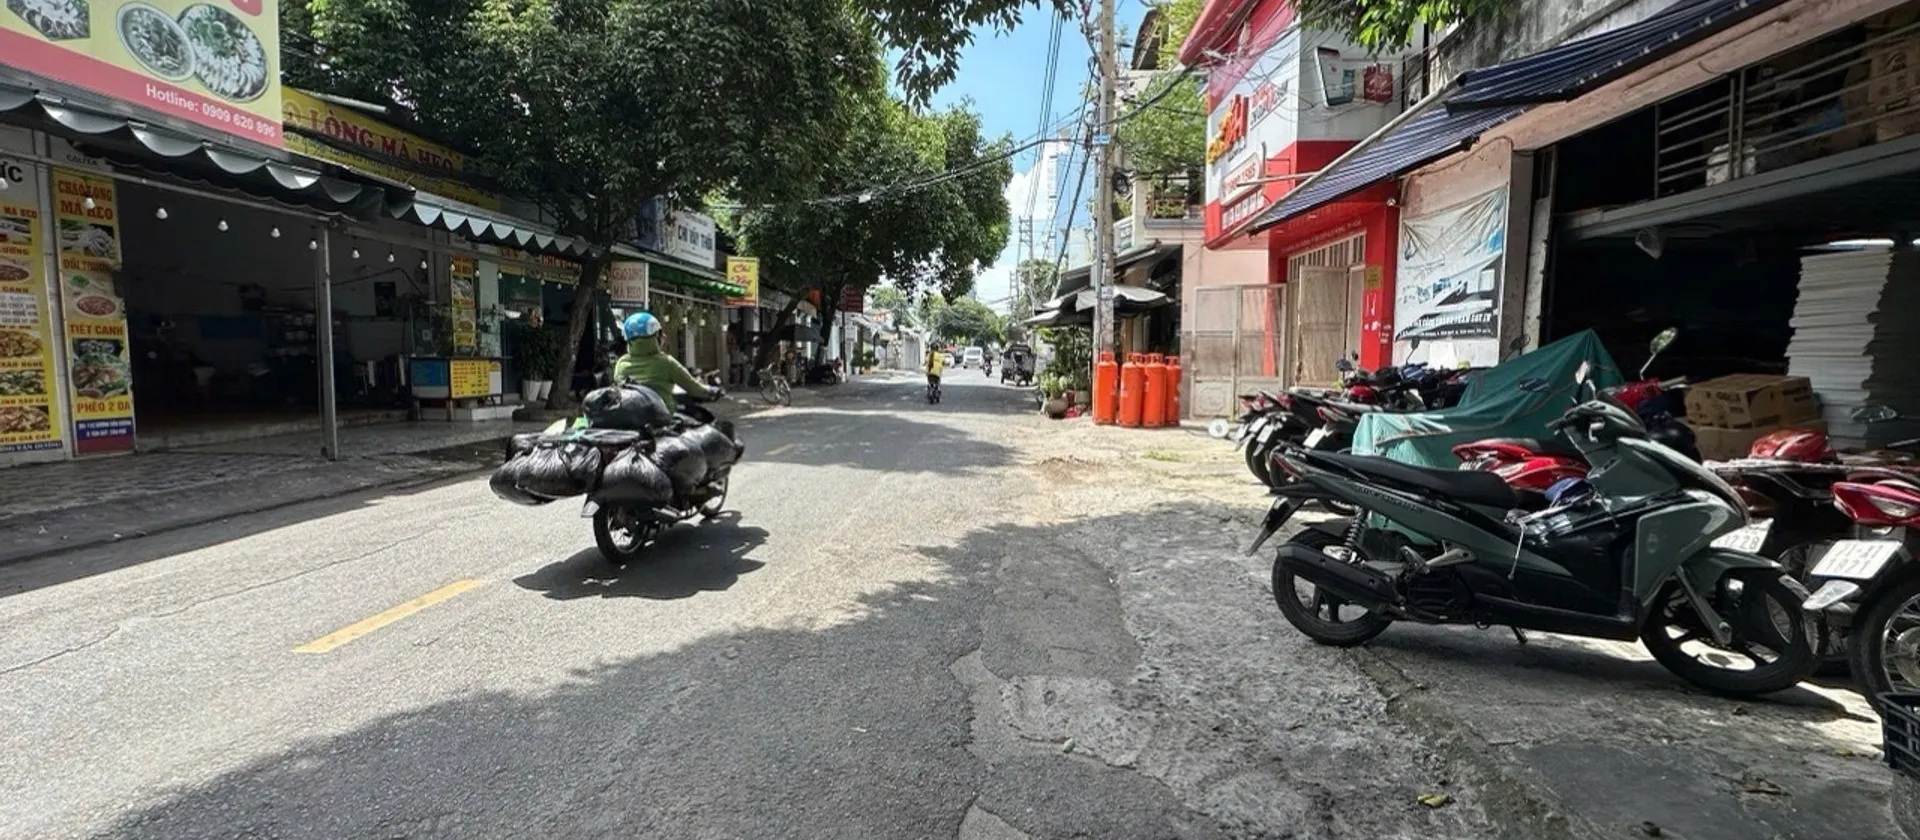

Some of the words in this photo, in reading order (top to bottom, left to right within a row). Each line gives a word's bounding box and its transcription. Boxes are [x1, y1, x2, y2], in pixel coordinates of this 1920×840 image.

[145, 83, 199, 113] Hotline:
[202, 102, 231, 124] 0909
[233, 112, 255, 131] 620
[309, 108, 376, 149] LÒNG
[380, 134, 412, 159] MÁ
[60, 199, 83, 216] MÁ
[95, 325, 123, 335] CANH
[108, 401, 115, 412] 2
